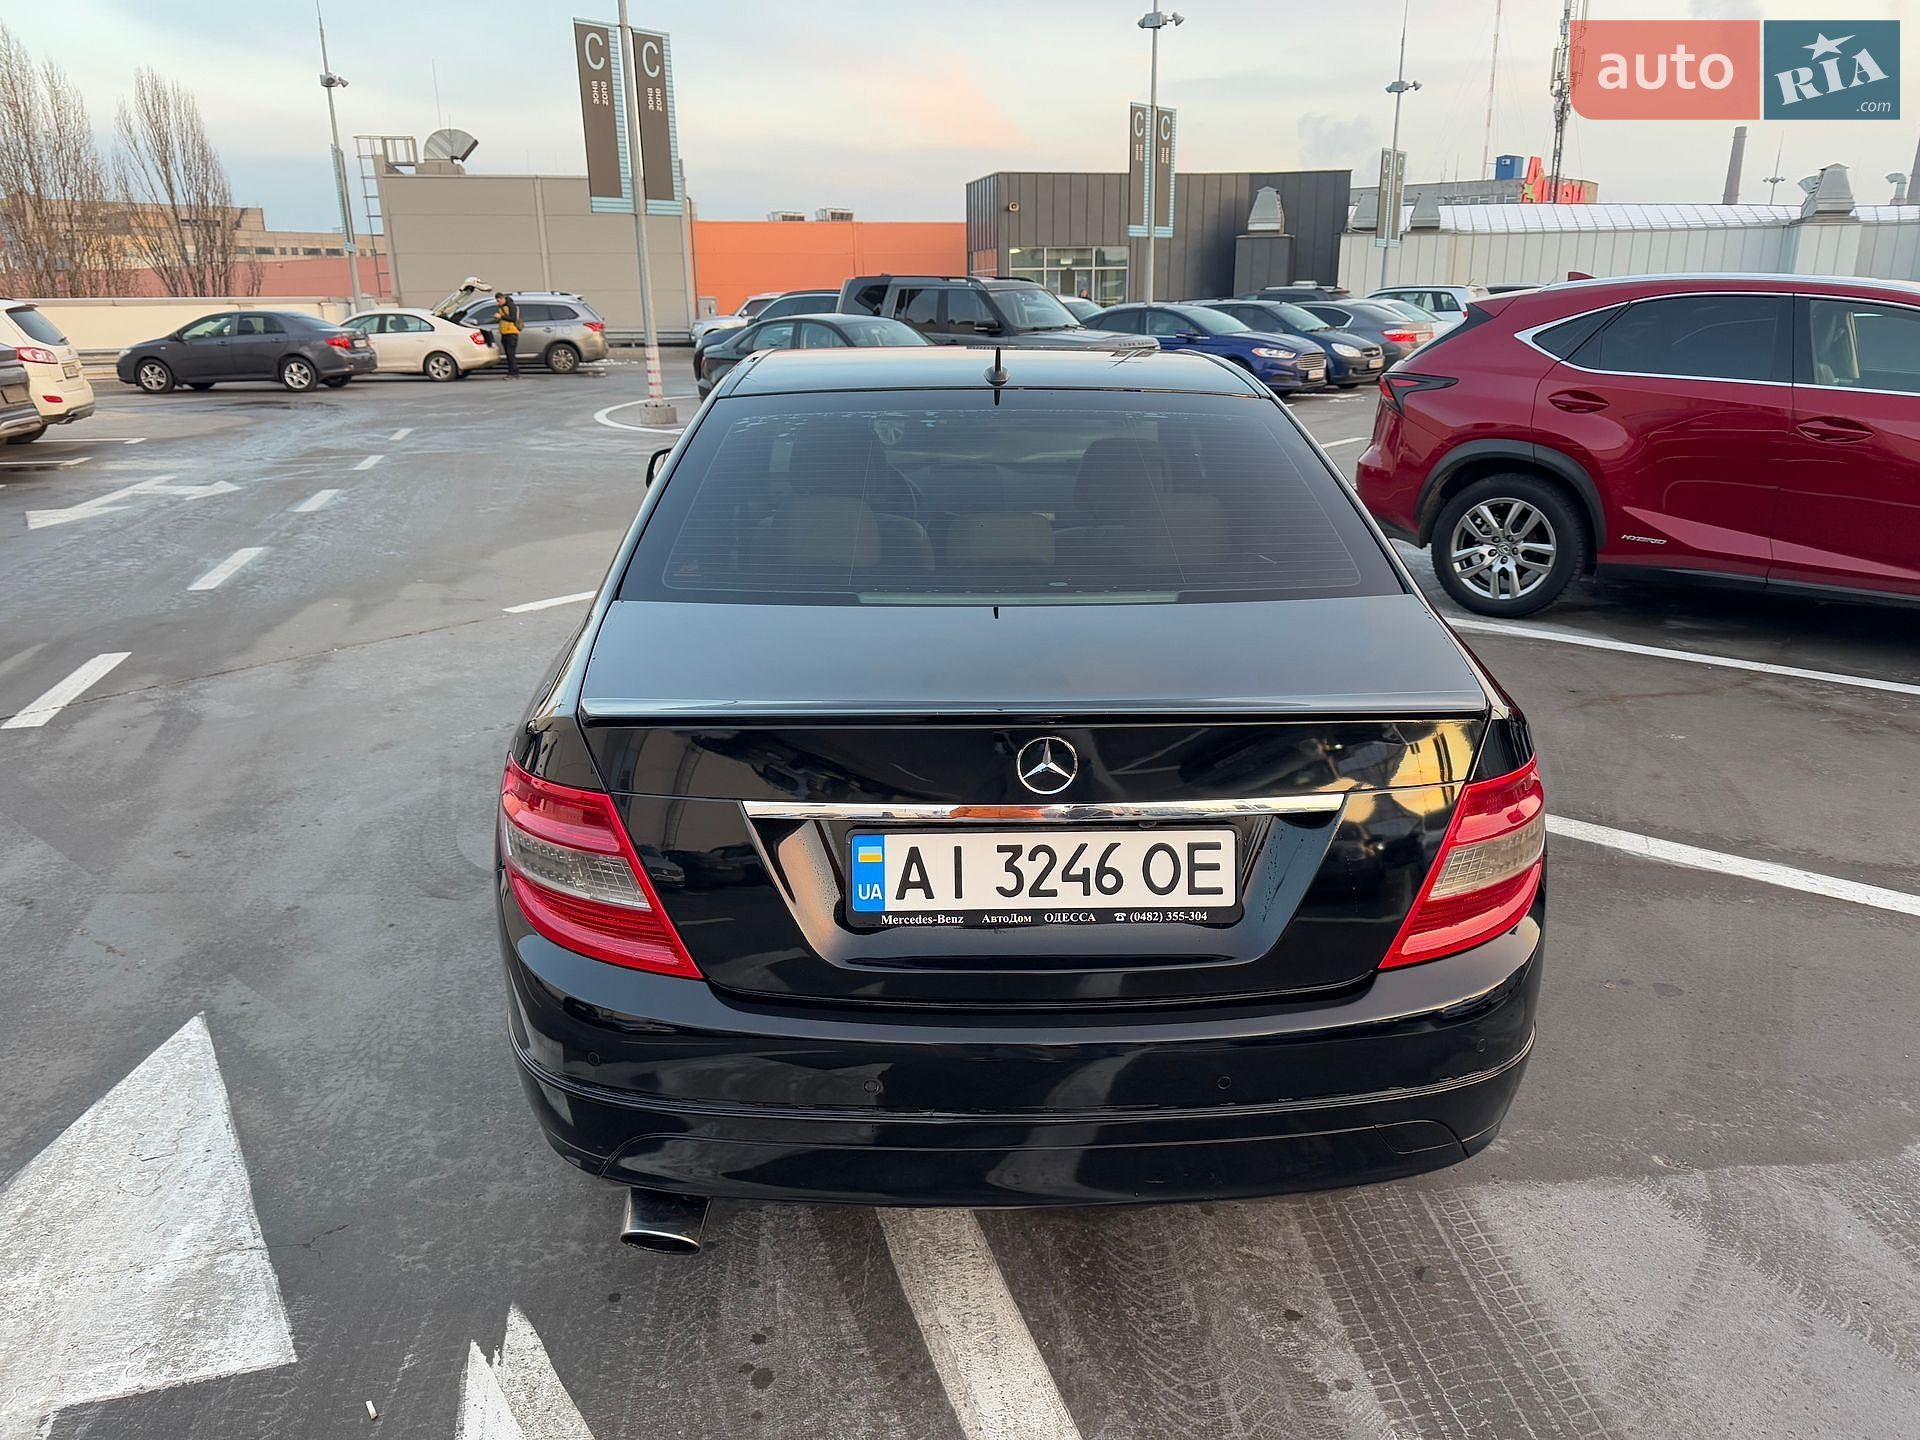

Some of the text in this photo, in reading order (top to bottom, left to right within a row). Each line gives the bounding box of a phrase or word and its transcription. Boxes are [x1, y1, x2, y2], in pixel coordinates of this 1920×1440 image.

[584, 32, 605, 70] C
[642, 41, 660, 78] C
[1134, 111, 1144, 137] C
[1161, 115, 1170, 141] C
[895, 841, 1223, 900] AI 3246 OE
[858, 884, 882, 900] UA
[880, 914, 964, 925] Mercedes-Benz
[981, 911, 1208, 924] АвтоДом ОДЕССА (0482) 355-304
